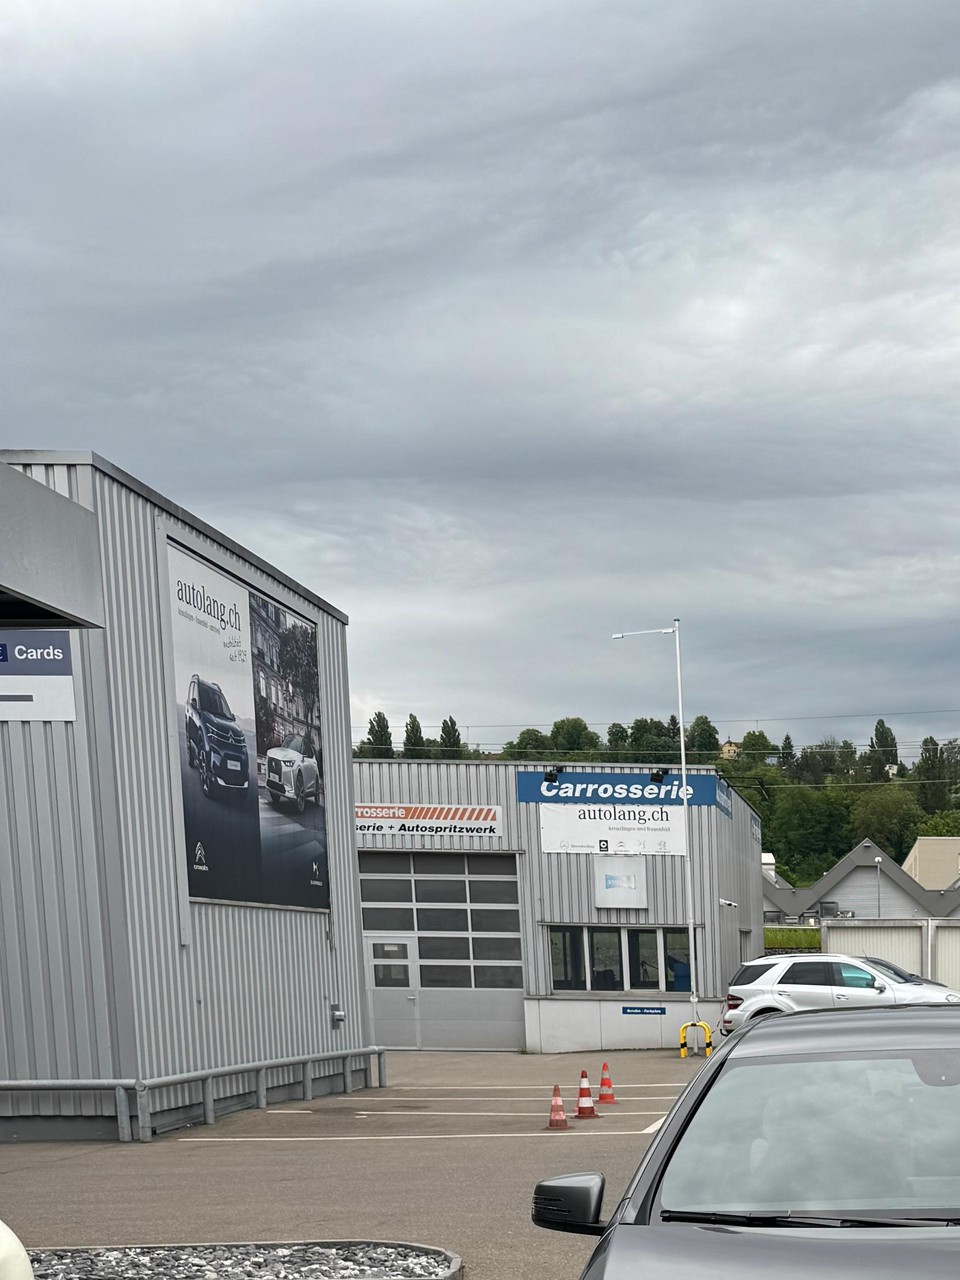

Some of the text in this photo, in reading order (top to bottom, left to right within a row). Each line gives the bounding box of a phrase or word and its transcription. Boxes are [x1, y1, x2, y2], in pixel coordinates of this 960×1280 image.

[177, 580, 241, 632] autolang.ch
[14, 645, 63, 660] Cards
[540, 780, 694, 800] Carrosserie
[578, 806, 670, 824] autolang.ch
[398, 823, 497, 834] Autospritzwerk
